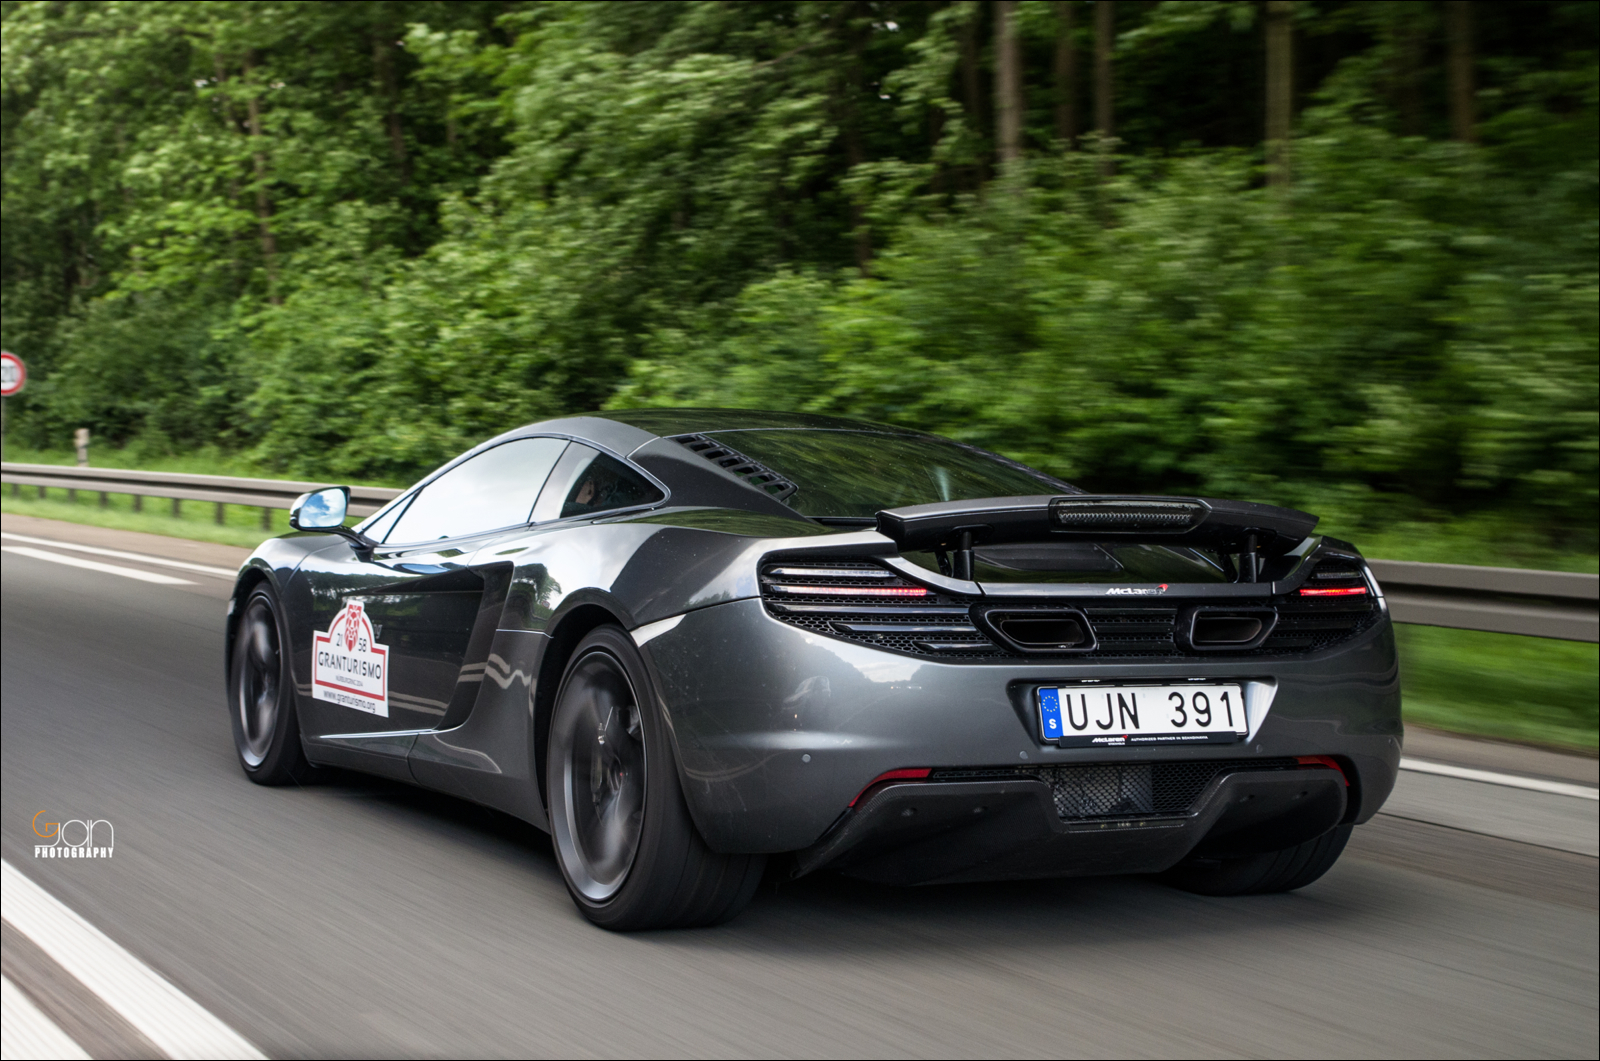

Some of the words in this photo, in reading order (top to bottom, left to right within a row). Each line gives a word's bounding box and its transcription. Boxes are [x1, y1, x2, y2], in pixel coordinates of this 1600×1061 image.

[1105, 587, 1165, 595] McLaren
[358, 637, 367, 653] 58
[318, 651, 382, 679] GRANTURISMO
[323, 690, 376, 713] www.granturismo.org
[1065, 692, 1140, 731] UJN
[1168, 691, 1234, 728] 391
[1049, 719, 1057, 729] S
